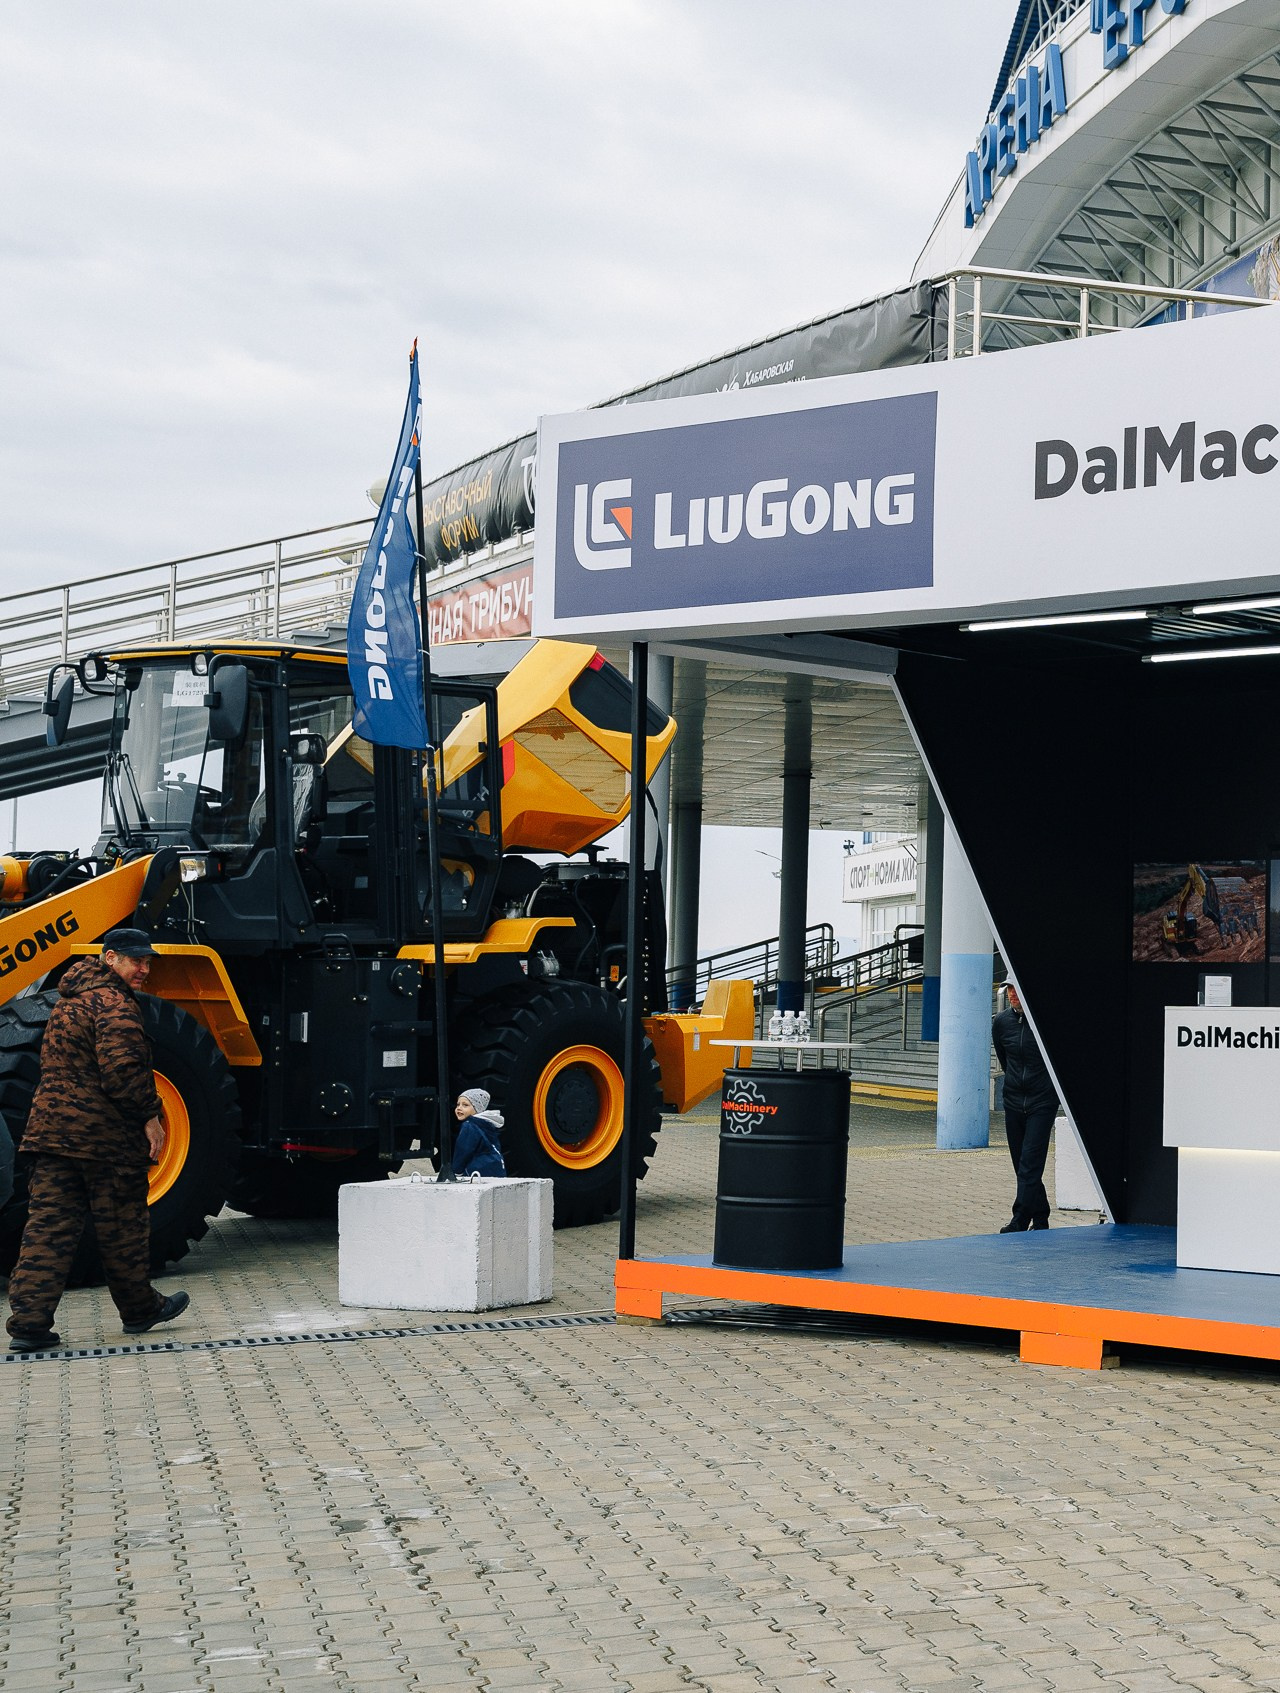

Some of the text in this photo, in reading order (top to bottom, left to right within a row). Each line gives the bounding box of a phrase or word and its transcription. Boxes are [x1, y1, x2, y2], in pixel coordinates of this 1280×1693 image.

[964, 43, 1066, 228] АРЕНА
[423, 469, 493, 527] ВЫСТАВОЧНЫЙ
[441, 513, 479, 550] ФОРУМ
[850, 864, 870, 889] СПОРТ
[875, 860, 900, 885] НОРМА
